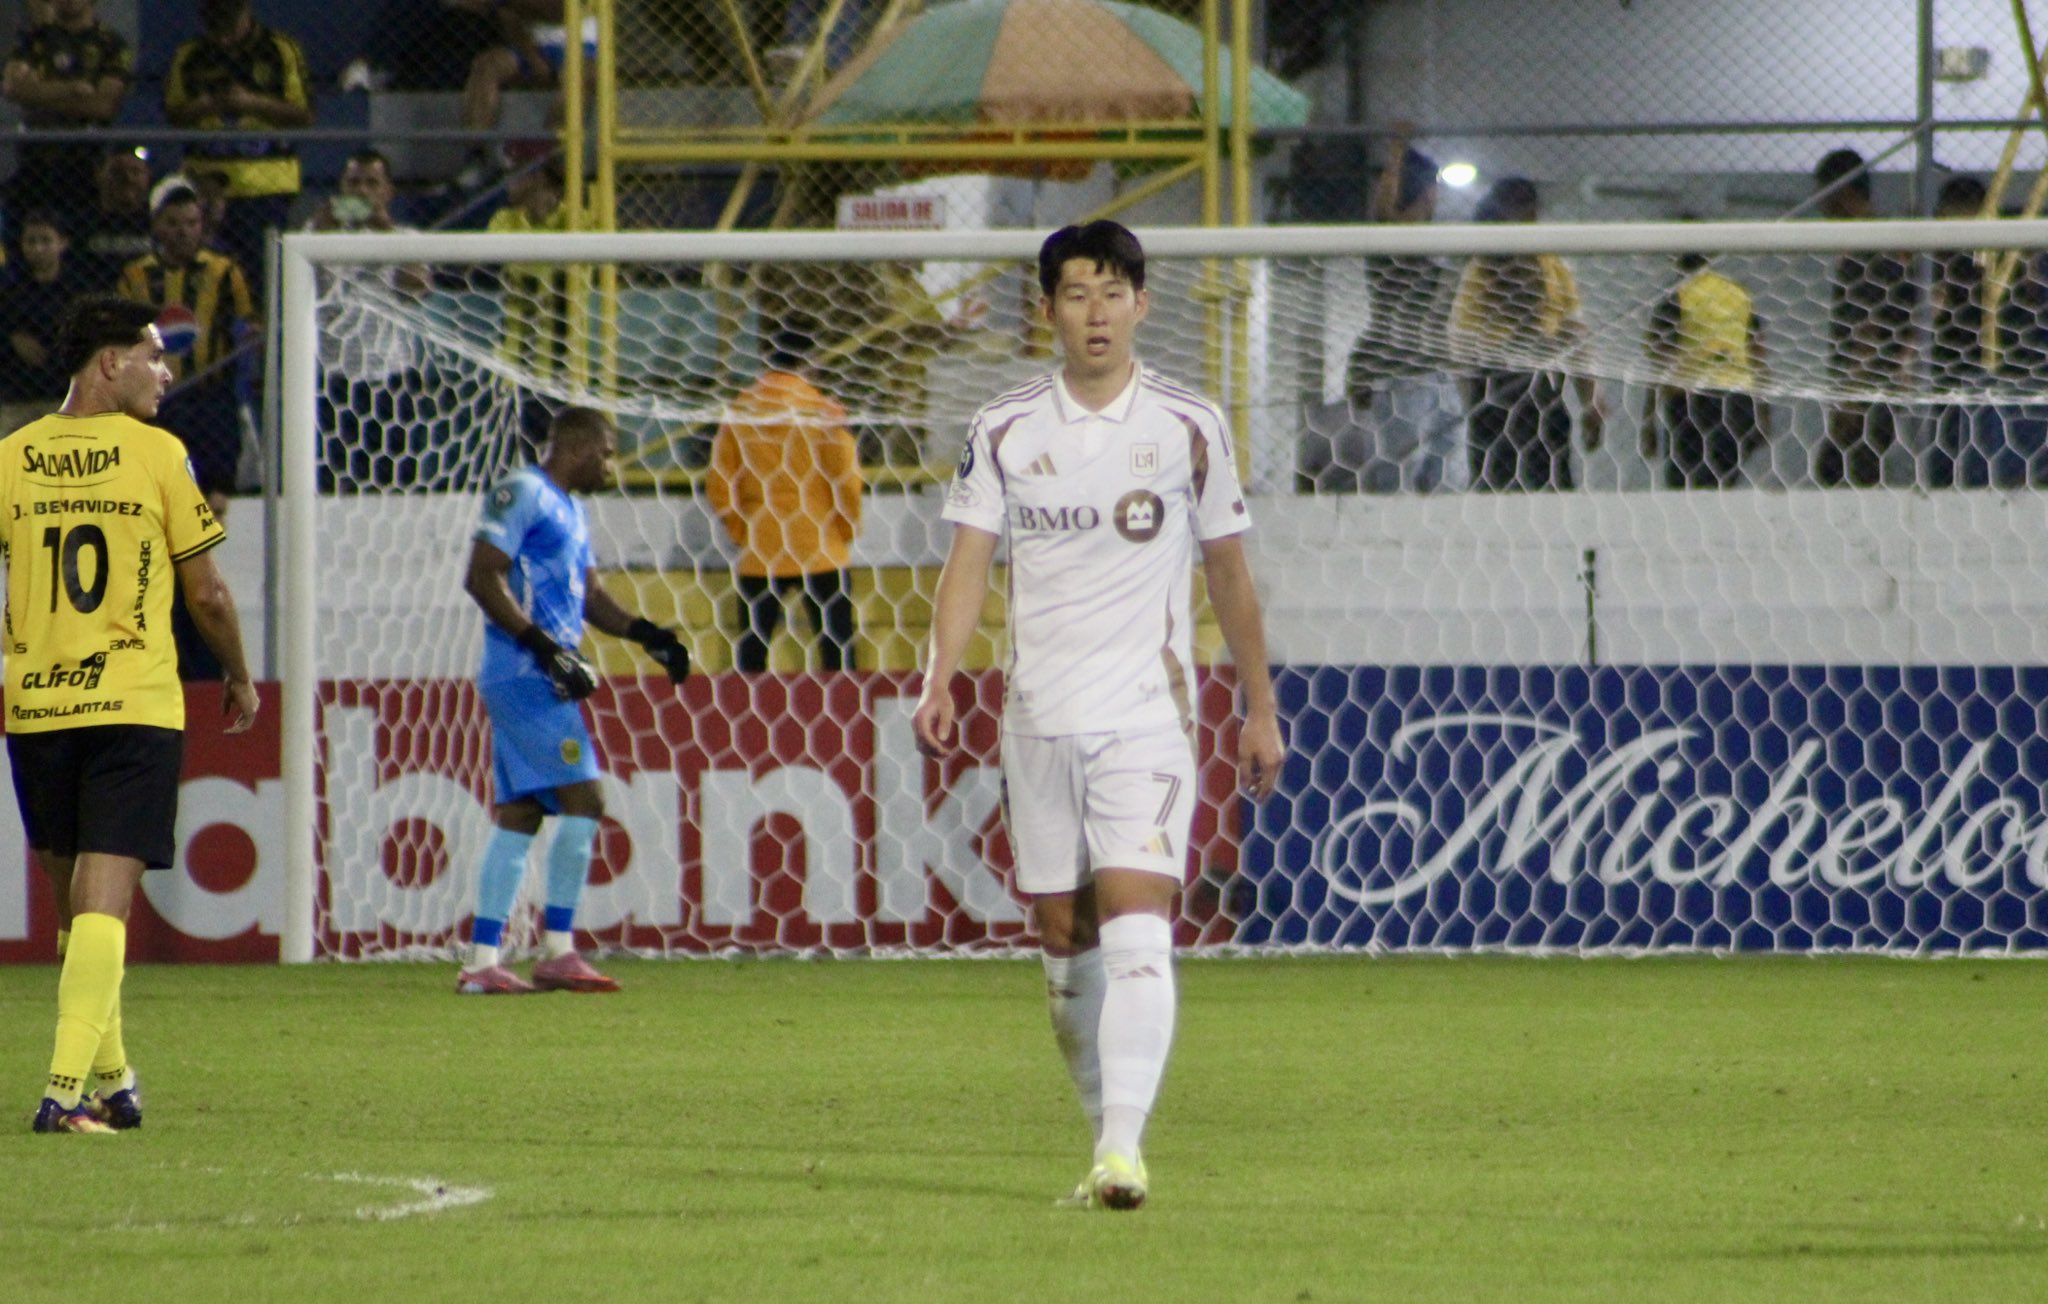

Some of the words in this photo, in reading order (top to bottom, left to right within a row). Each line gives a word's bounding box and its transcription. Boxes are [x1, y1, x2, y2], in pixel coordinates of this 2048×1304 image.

[12, 504, 28, 520] J.
[1018, 505, 1100, 531] BMO
[43, 524, 109, 614] 10
[110, 639, 146, 651] BMS
[1152, 772, 1181, 827] 7
